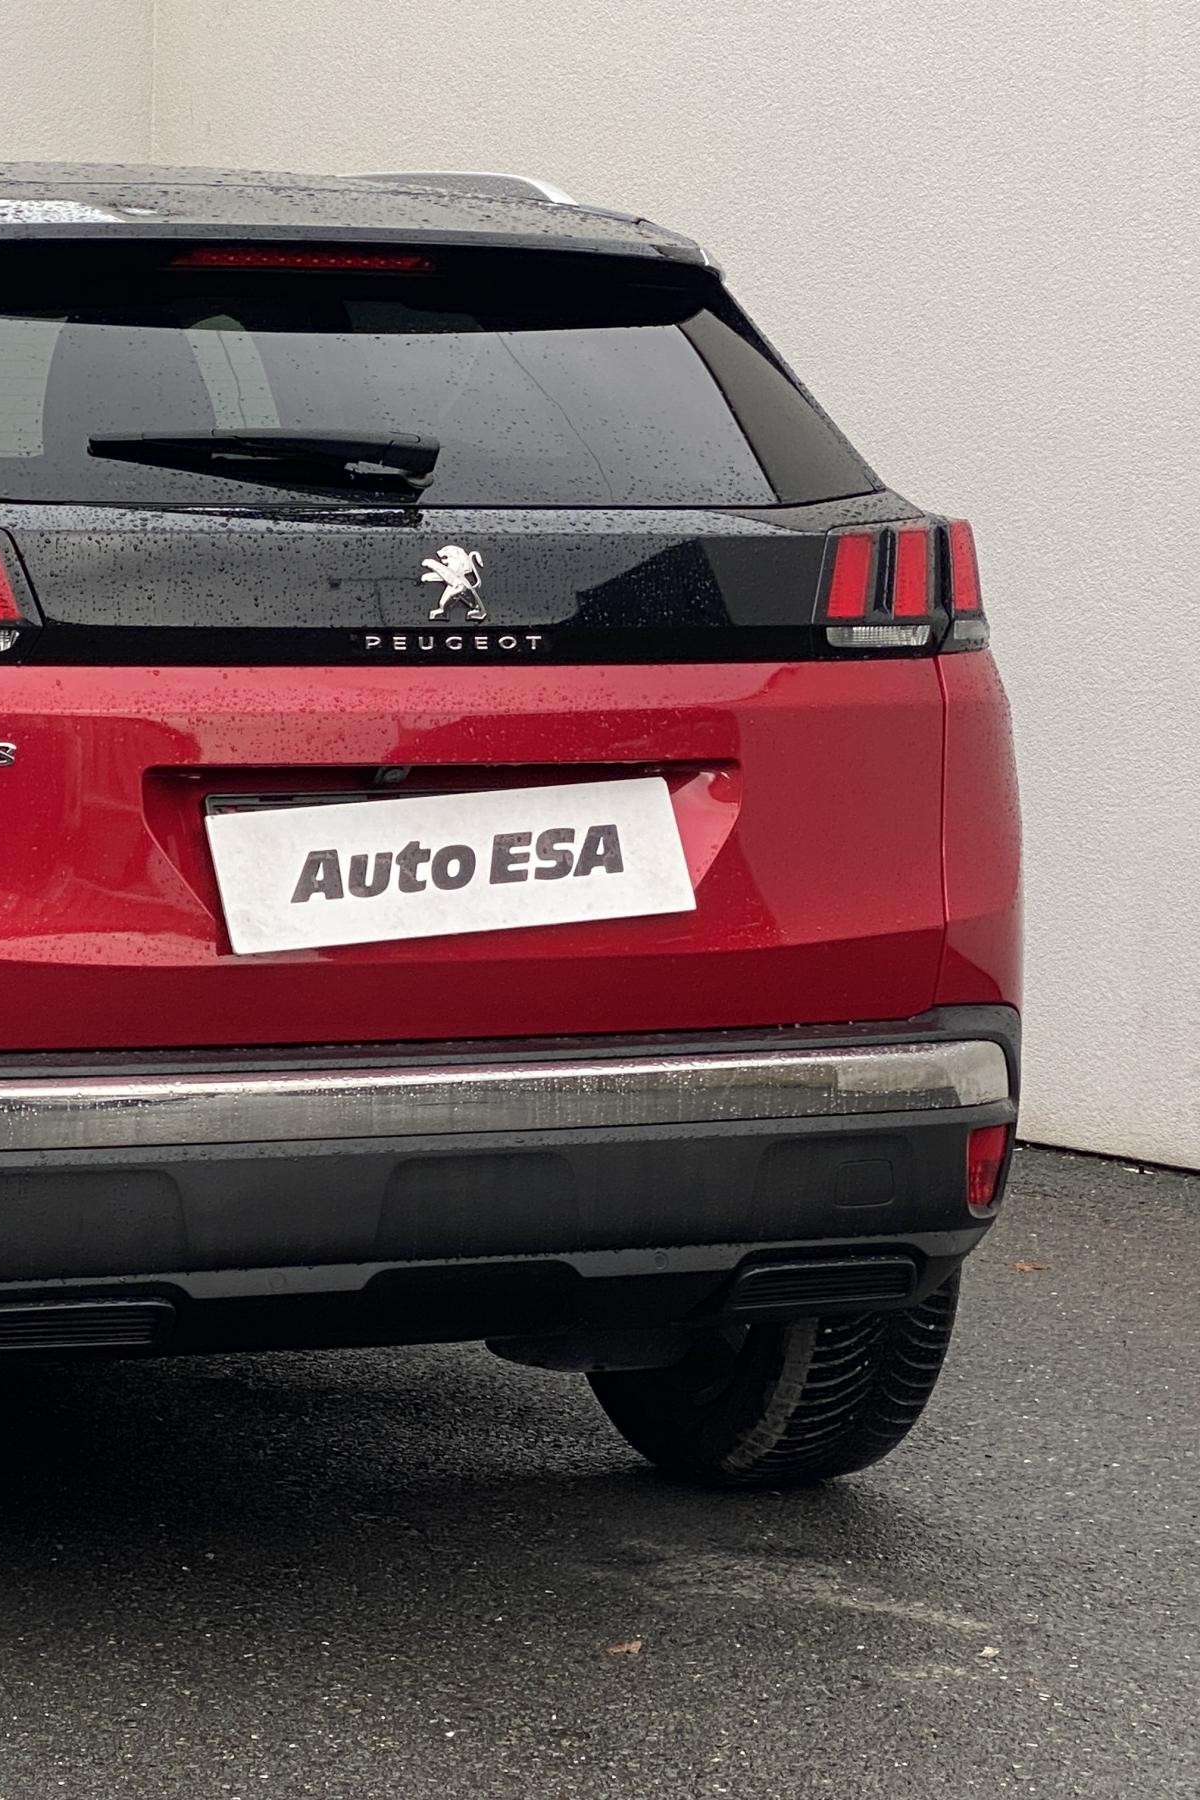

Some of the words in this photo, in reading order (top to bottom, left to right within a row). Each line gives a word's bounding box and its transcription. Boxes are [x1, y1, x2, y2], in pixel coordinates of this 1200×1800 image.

[364, 635, 542, 651] PEUGEOT
[290, 840, 477, 904] Auto
[489, 823, 625, 885] ESA
